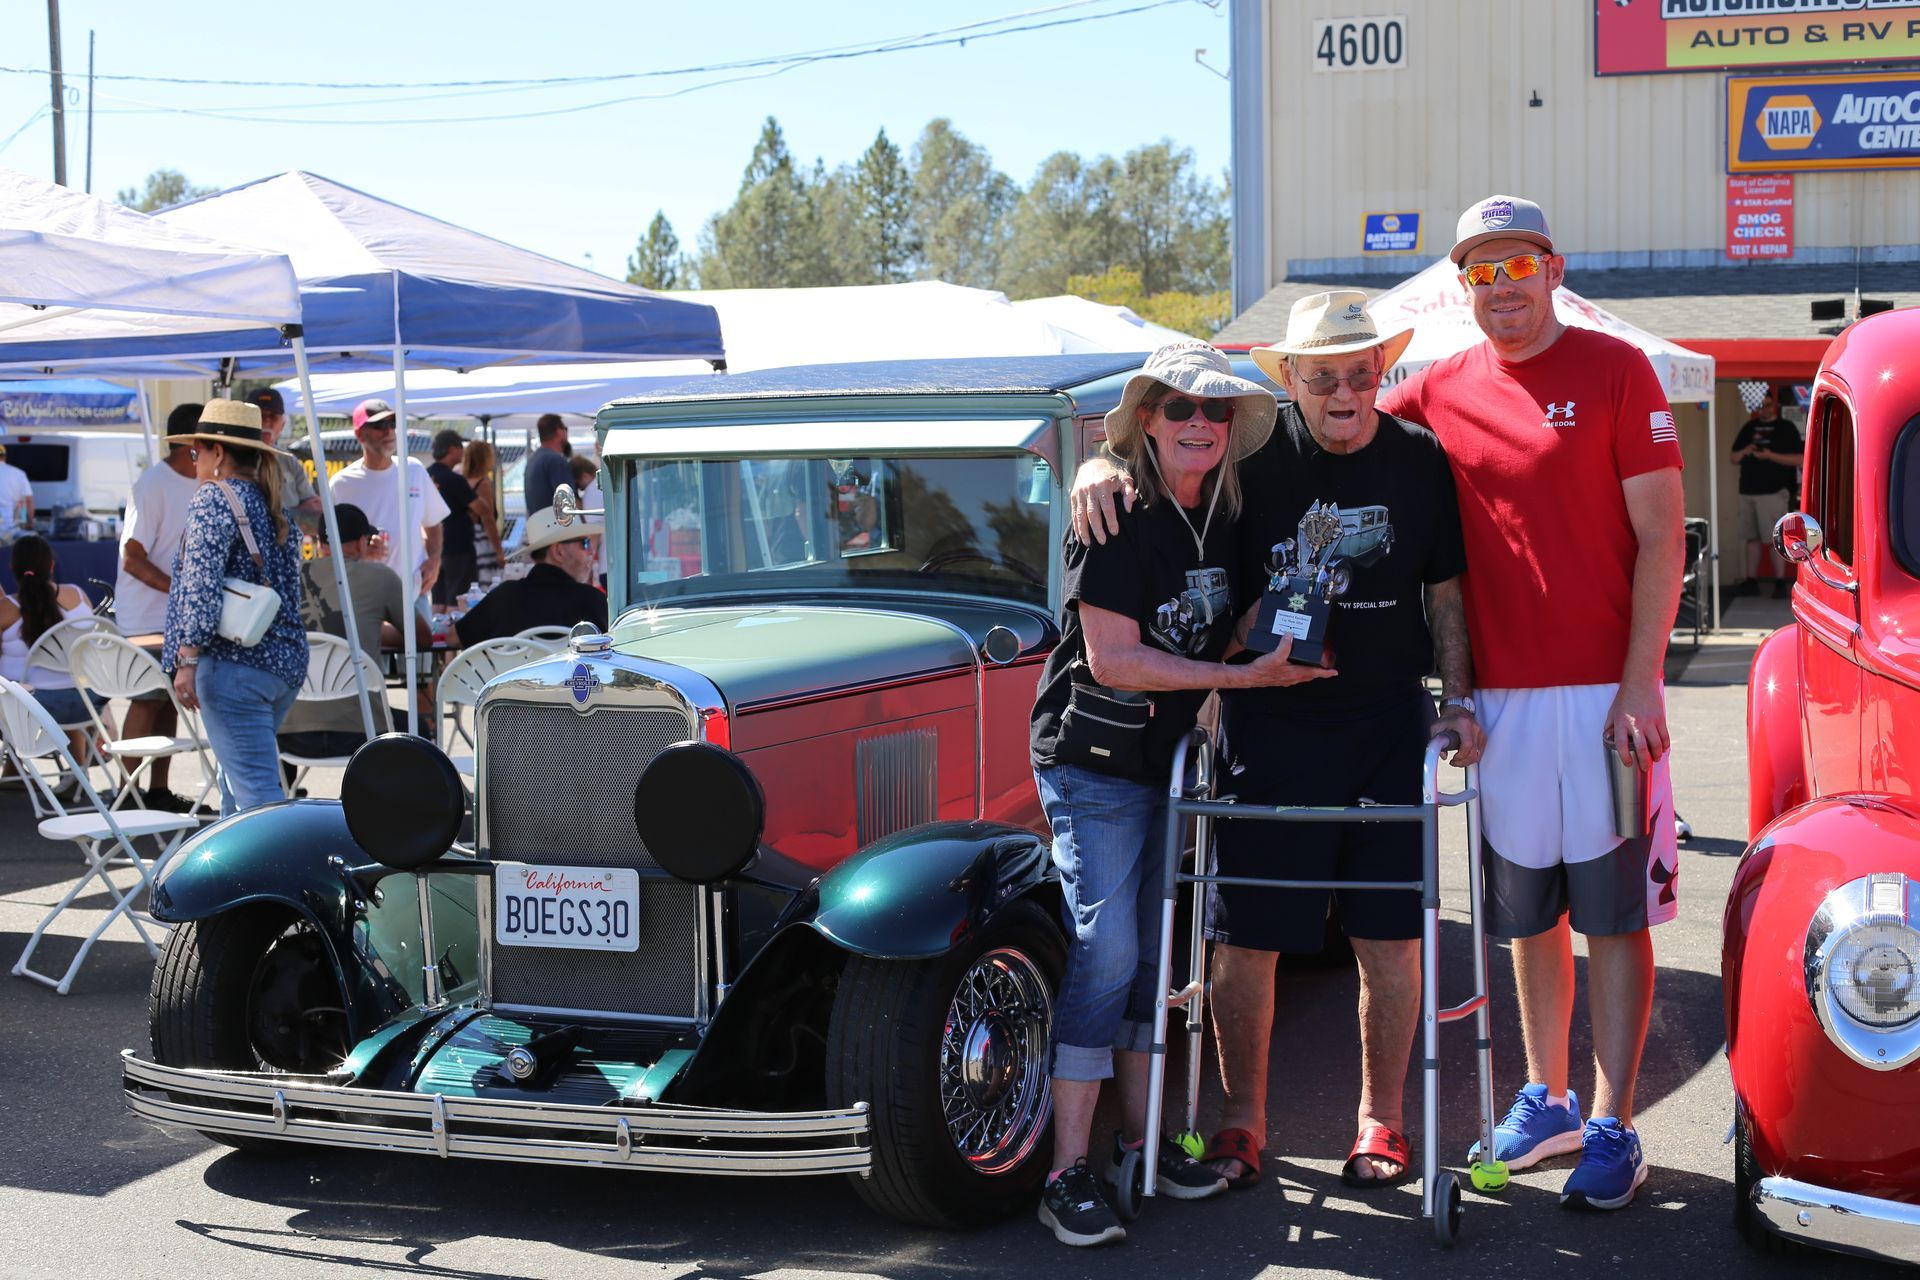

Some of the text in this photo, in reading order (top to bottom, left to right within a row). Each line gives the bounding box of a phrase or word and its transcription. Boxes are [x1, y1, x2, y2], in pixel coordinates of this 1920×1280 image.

[1690, 26, 1790, 48] AUTO
[1804, 24, 1829, 43] &
[1842, 21, 1892, 42] RV
[1317, 21, 1402, 66] 4600
[1768, 110, 1811, 135] NAPA
[1738, 213, 1781, 225] SMOG
[1734, 226, 1786, 238] CHECK
[1731, 244, 1787, 255] TEST & REPAIR
[1541, 420, 1576, 429] FREEDOM
[1378, 600, 1397, 609] SEDAN
[526, 871, 612, 895] California
